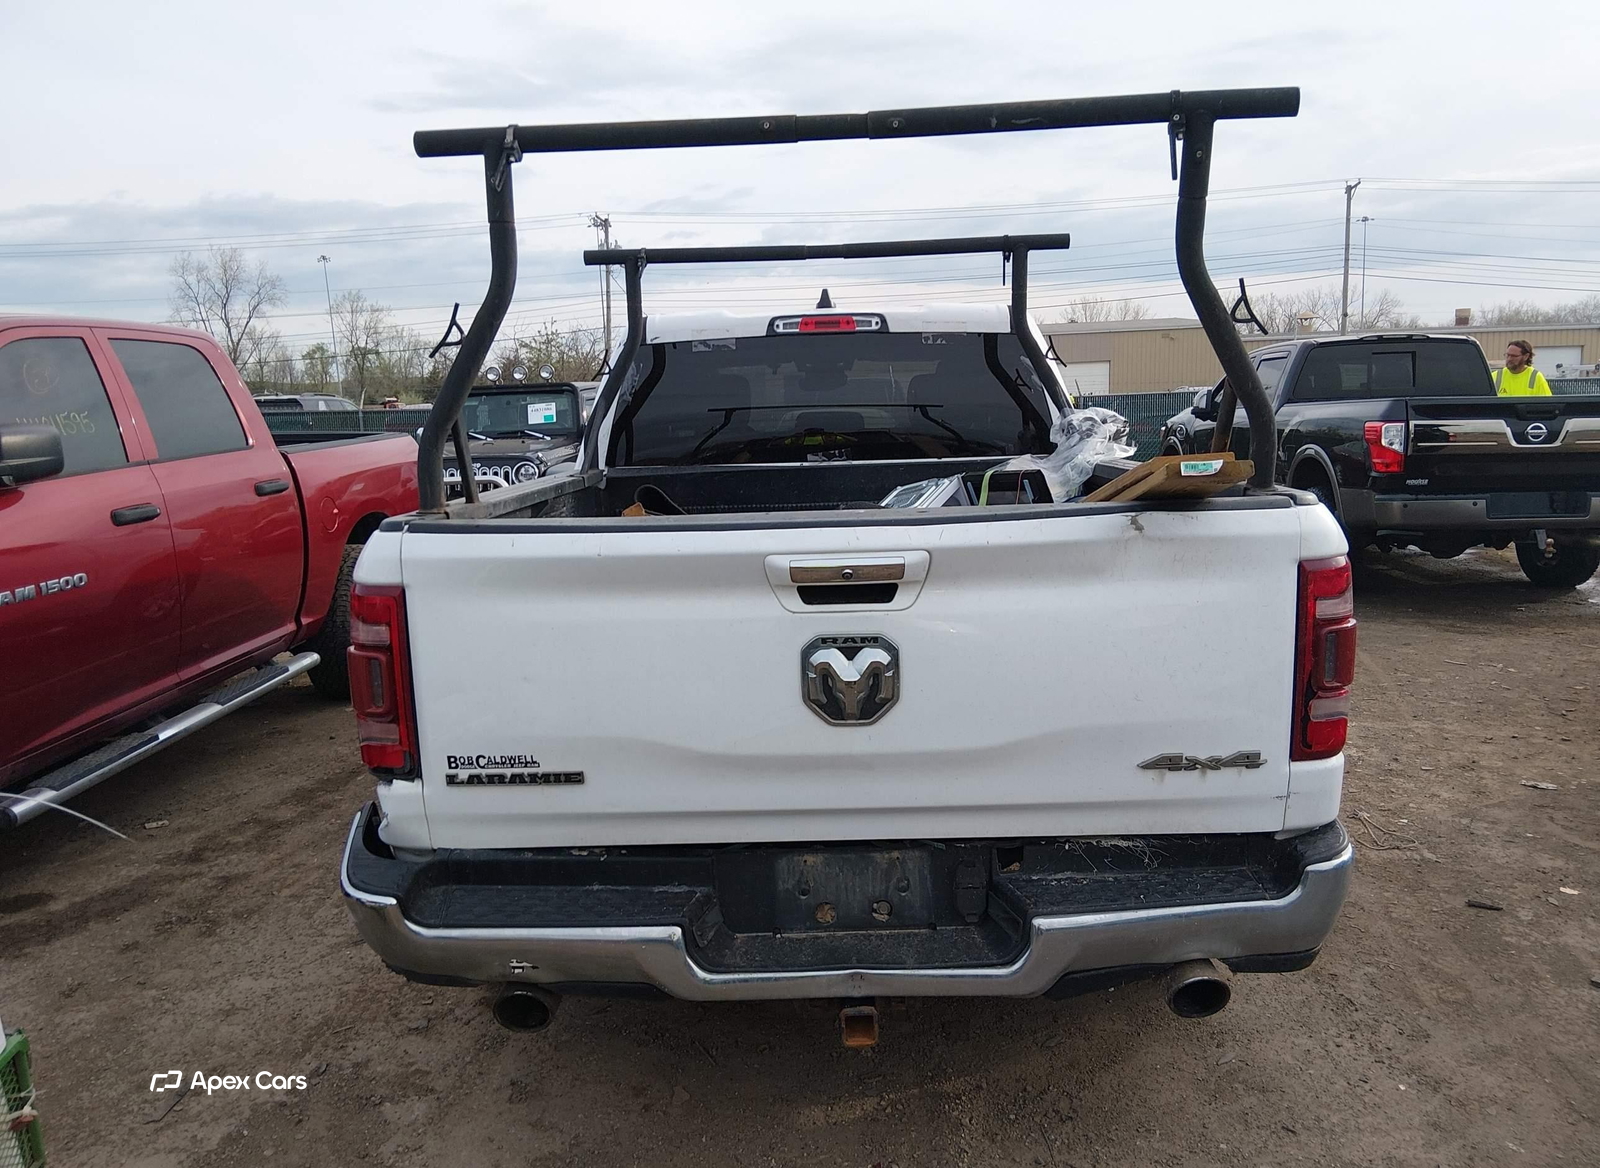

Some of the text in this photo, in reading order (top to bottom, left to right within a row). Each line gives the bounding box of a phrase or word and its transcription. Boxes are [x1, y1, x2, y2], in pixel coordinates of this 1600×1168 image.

[0, 573, 88, 606] AM 1500
[821, 637, 879, 645] RAM
[447, 754, 539, 769] BOB CALDWELL
[445, 772, 584, 786] LARAMIE
